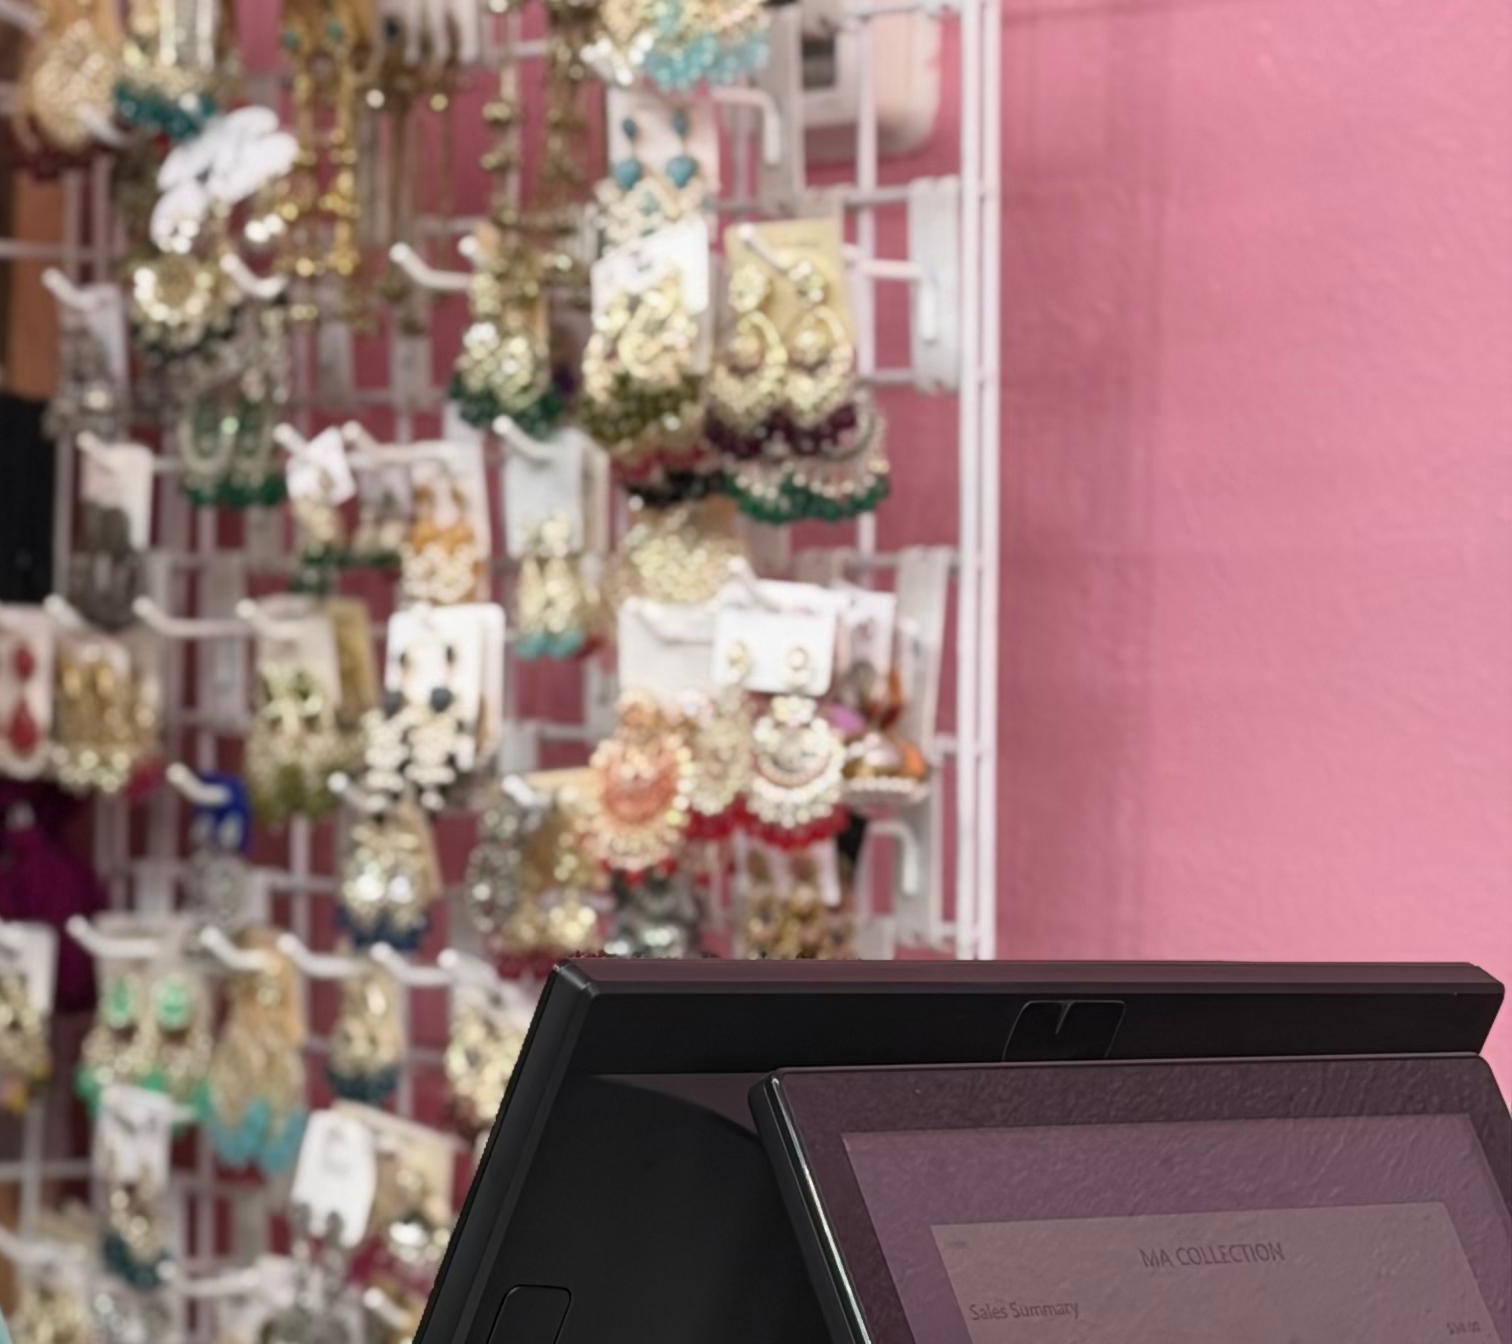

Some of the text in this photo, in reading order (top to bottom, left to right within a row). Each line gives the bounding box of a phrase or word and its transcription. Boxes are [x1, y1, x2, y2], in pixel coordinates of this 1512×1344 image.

[1139, 1242, 1286, 1269] MA COLLECTION
[968, 1301, 1080, 1321] Sales Summary
